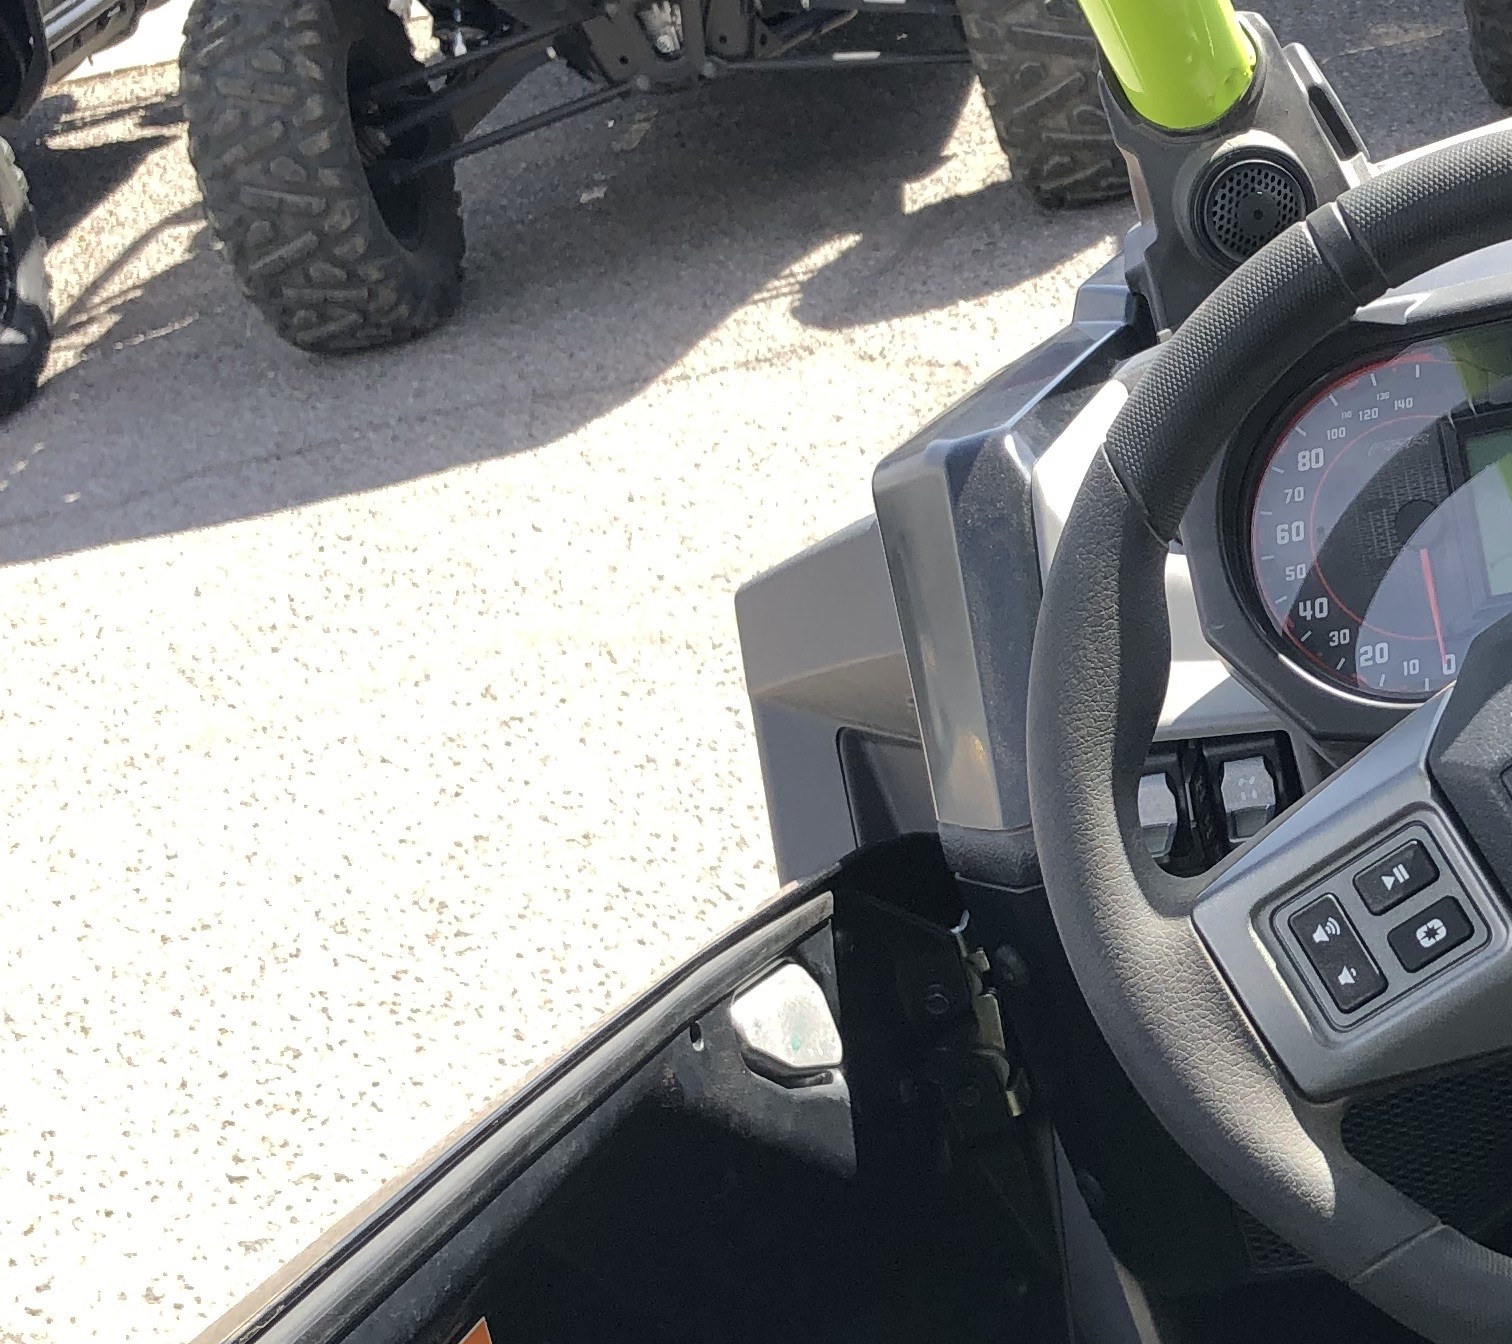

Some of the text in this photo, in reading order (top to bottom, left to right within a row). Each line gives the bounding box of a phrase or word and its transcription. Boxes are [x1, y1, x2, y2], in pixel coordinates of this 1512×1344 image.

[1394, 397, 1414, 411] 140
[1359, 407, 1379, 421] 120
[1327, 427, 1346, 441] 100
[1297, 448, 1325, 472] 80
[1284, 486, 1304, 504] 70
[1276, 520, 1305, 545] 60
[1285, 563, 1306, 582] 50
[1298, 597, 1328, 621] 40
[1329, 629, 1350, 646] 30
[1359, 642, 1389, 667] 20
[1402, 659, 1420, 677] 10
[1442, 654, 1456, 676] 0
